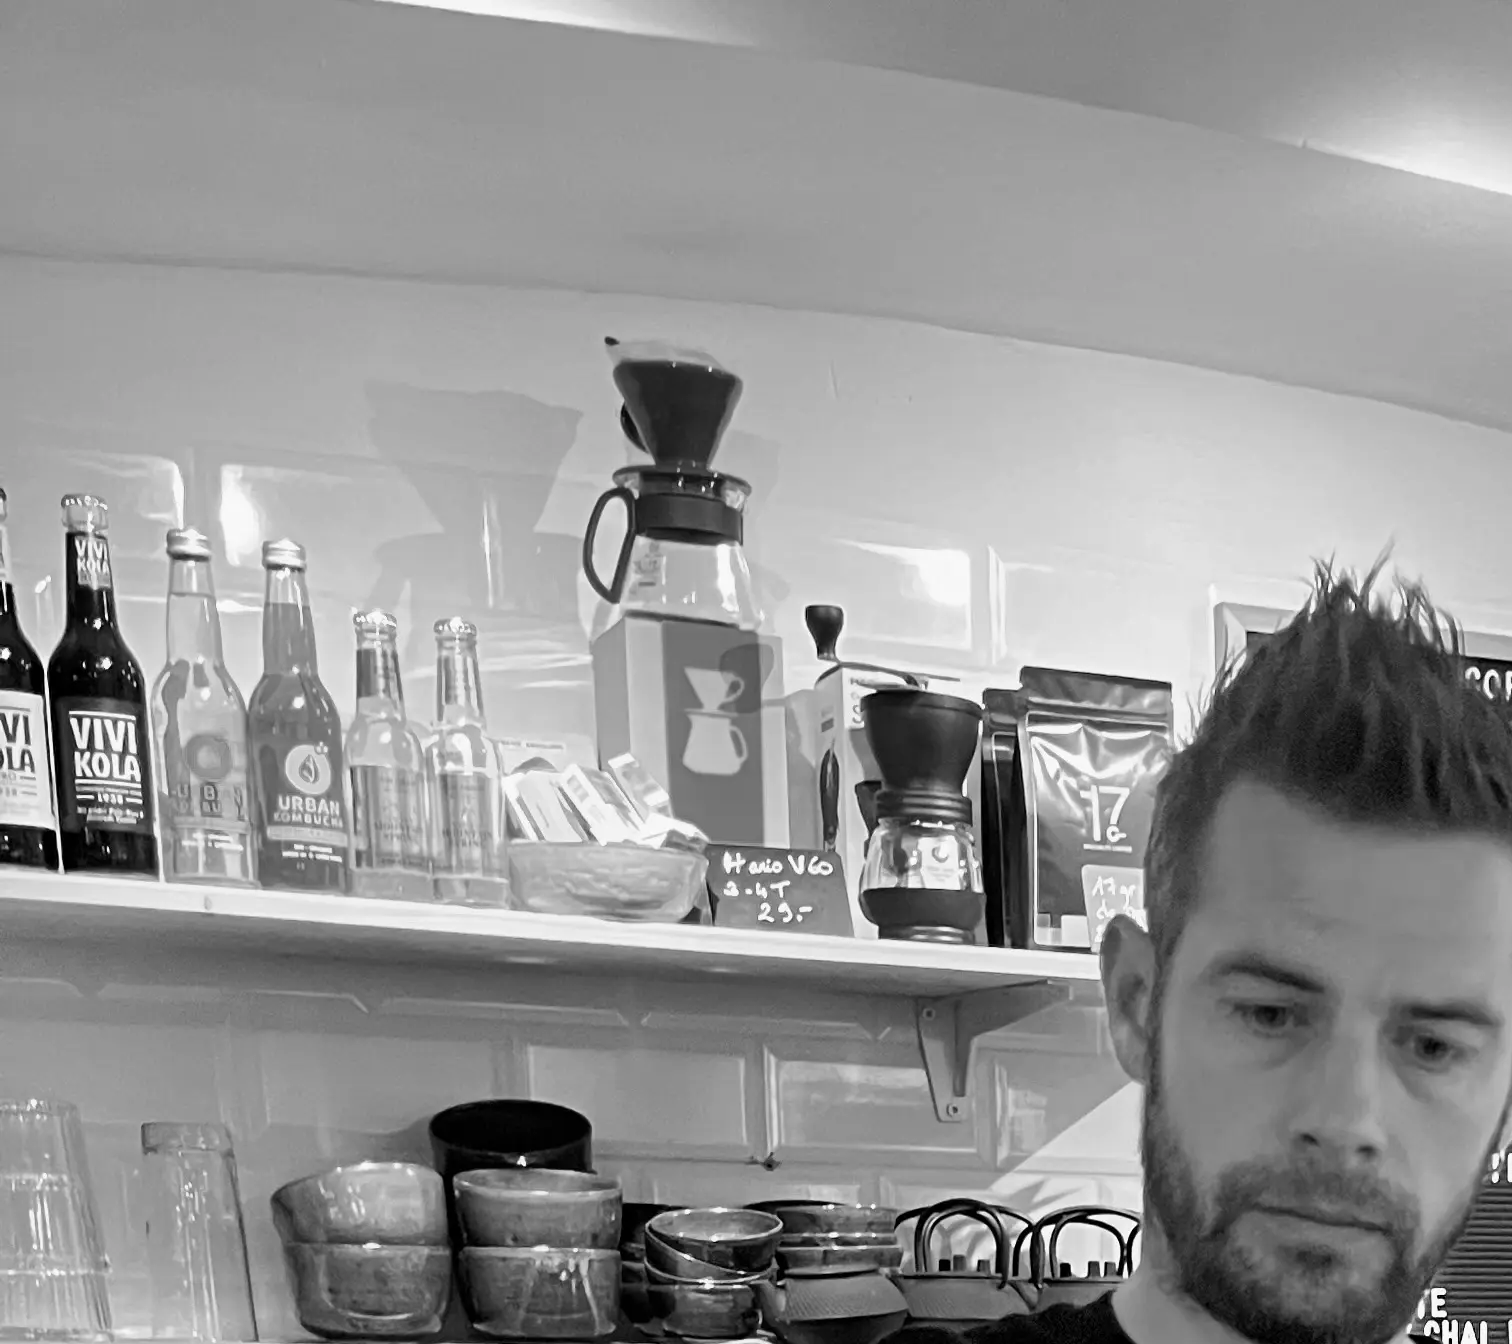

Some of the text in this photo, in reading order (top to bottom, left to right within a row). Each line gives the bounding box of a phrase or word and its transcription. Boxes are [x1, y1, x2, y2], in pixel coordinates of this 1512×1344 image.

[70, 717, 138, 754] VIVI
[74, 751, 142, 782] KOLA
[278, 795, 341, 817] URBAN
[1080, 785, 1130, 841] 17
